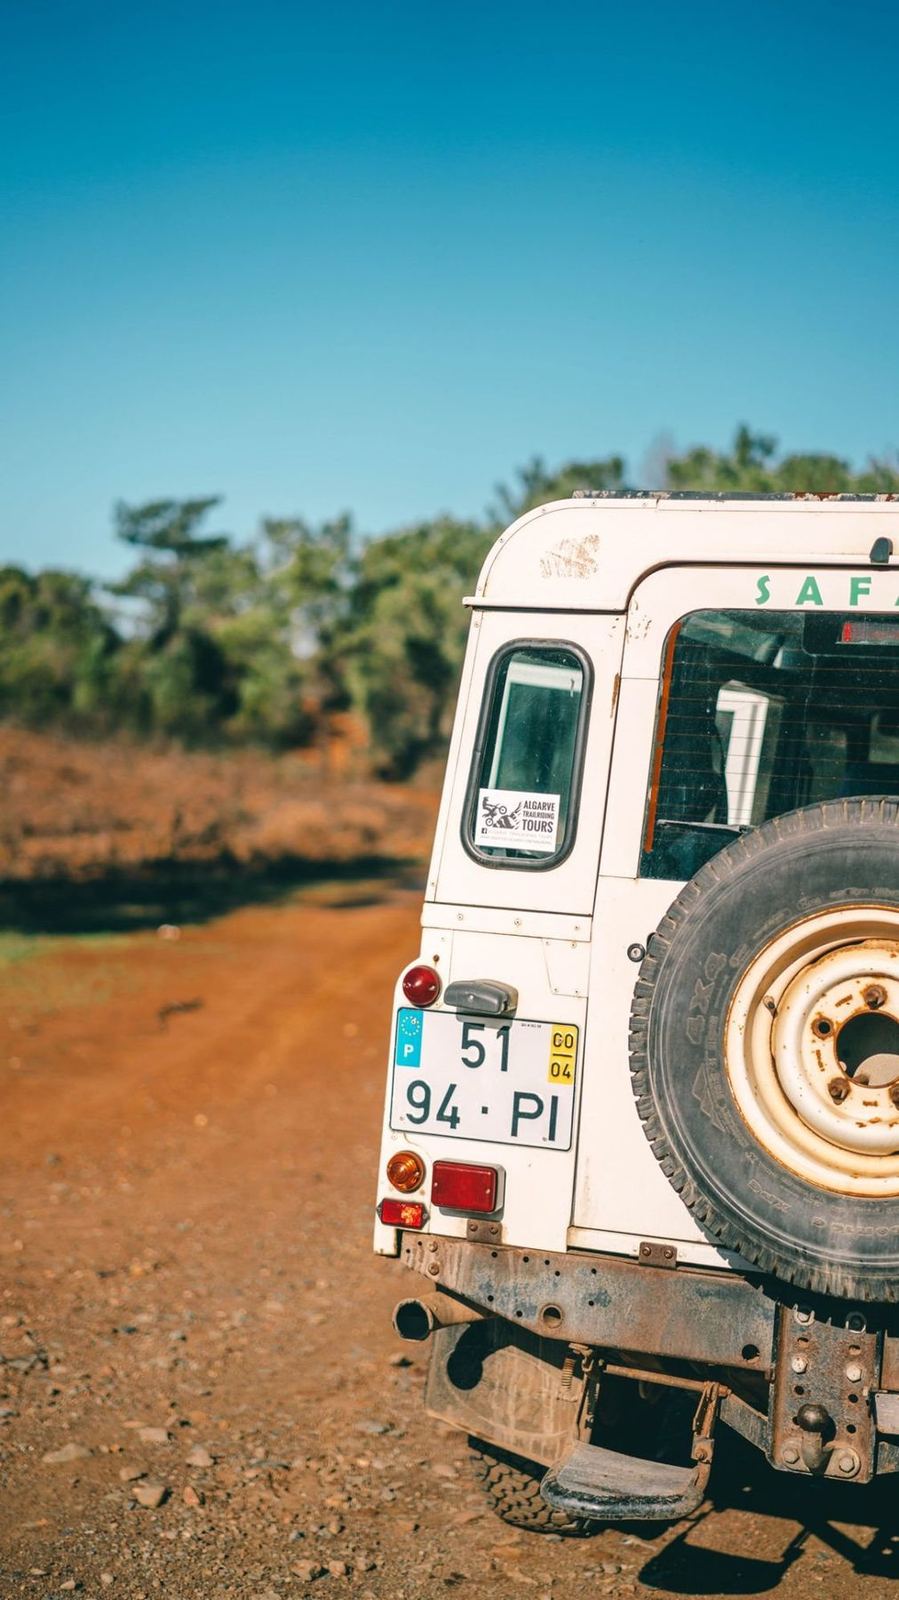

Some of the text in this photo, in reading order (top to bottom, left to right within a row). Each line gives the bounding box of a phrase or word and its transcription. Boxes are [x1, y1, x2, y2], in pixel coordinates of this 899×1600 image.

[755, 575, 899, 607] SAF
[523, 800, 555, 811] ALGARVE
[522, 819, 554, 833] TOURS
[403, 1044, 414, 1058] P
[461, 1022, 511, 1072] 51
[550, 1062, 571, 1079] 04
[406, 1079, 461, 1130] 94
[511, 1091, 559, 1142] PI
